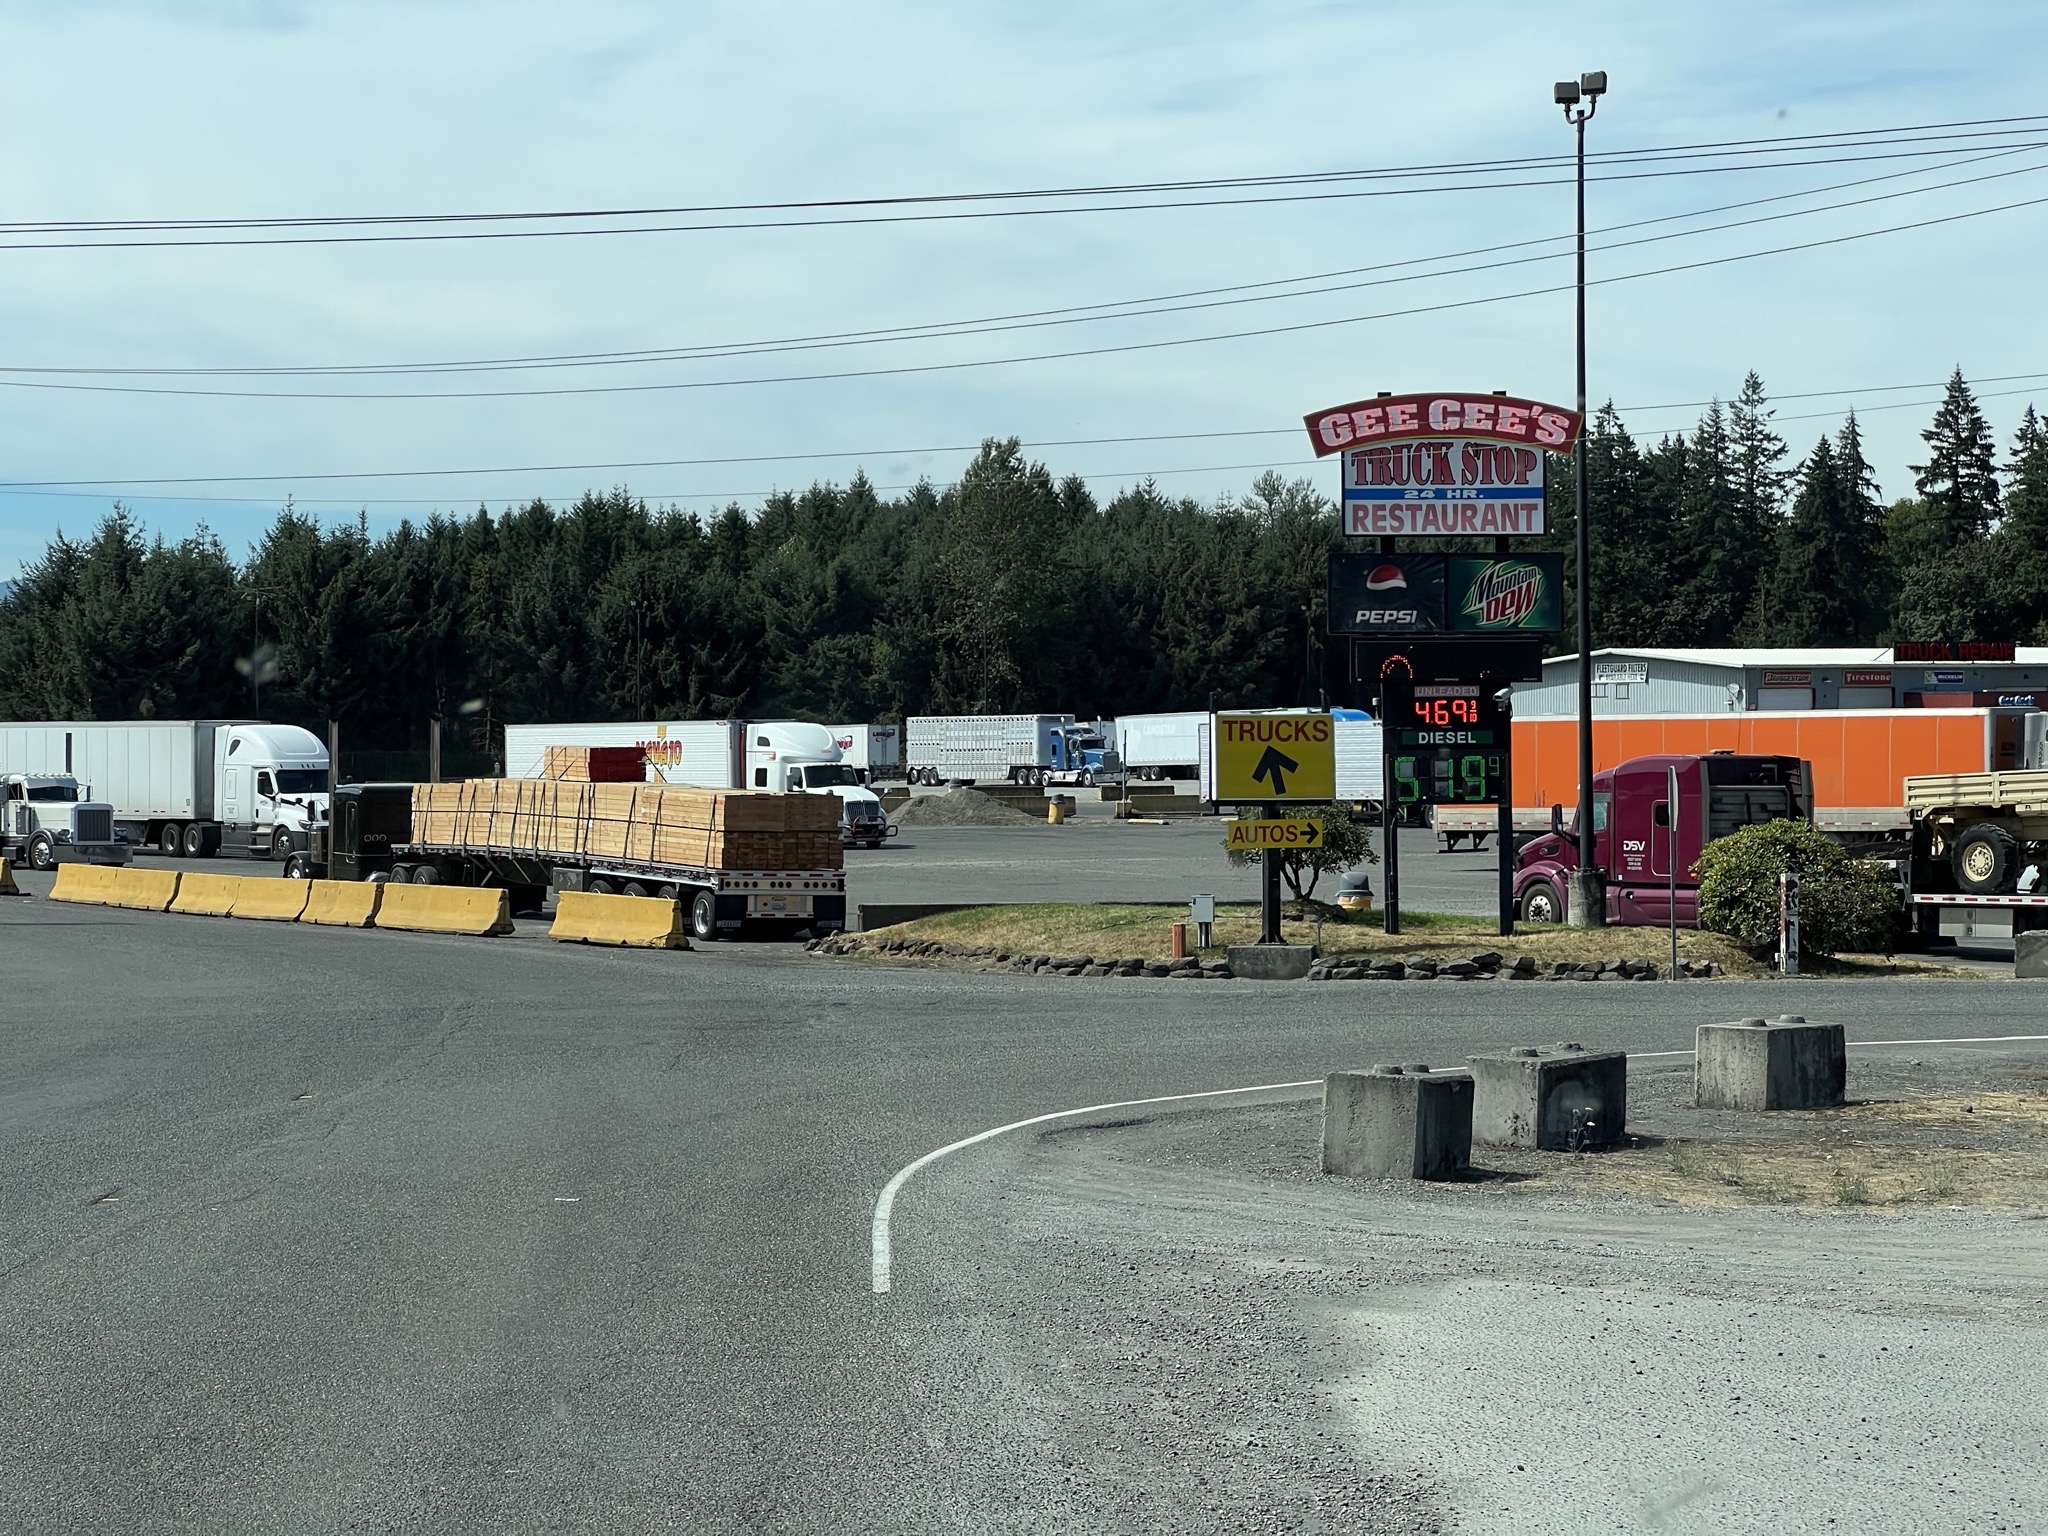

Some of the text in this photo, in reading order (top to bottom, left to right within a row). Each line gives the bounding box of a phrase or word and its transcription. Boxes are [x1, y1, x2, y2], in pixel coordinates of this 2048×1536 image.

[1318, 399, 1570, 447] GEE CEE'S
[1351, 442, 1537, 486] TRUCK STOP
[1403, 489, 1484, 499] 24 HR.
[1352, 503, 1538, 533] RESTAURANT
[1475, 568, 1538, 607] Mountain
[1355, 610, 1417, 624] PEPSI
[1896, 642, 2015, 660] TRUCK REPAIR
[1628, 663, 1647, 672] FILTERS
[1845, 673, 1891, 682] Firestone
[1417, 686, 1478, 697] UNLEADED
[1415, 699, 1467, 725] 4.69
[1222, 720, 1329, 742] TRUCKS
[1418, 731, 1477, 744] DIESEL
[636, 740, 682, 770] AVAJO
[1395, 756, 1486, 801] 5.19
[1231, 825, 1298, 843] AUTOS
[1623, 840, 1646, 851] DSV
